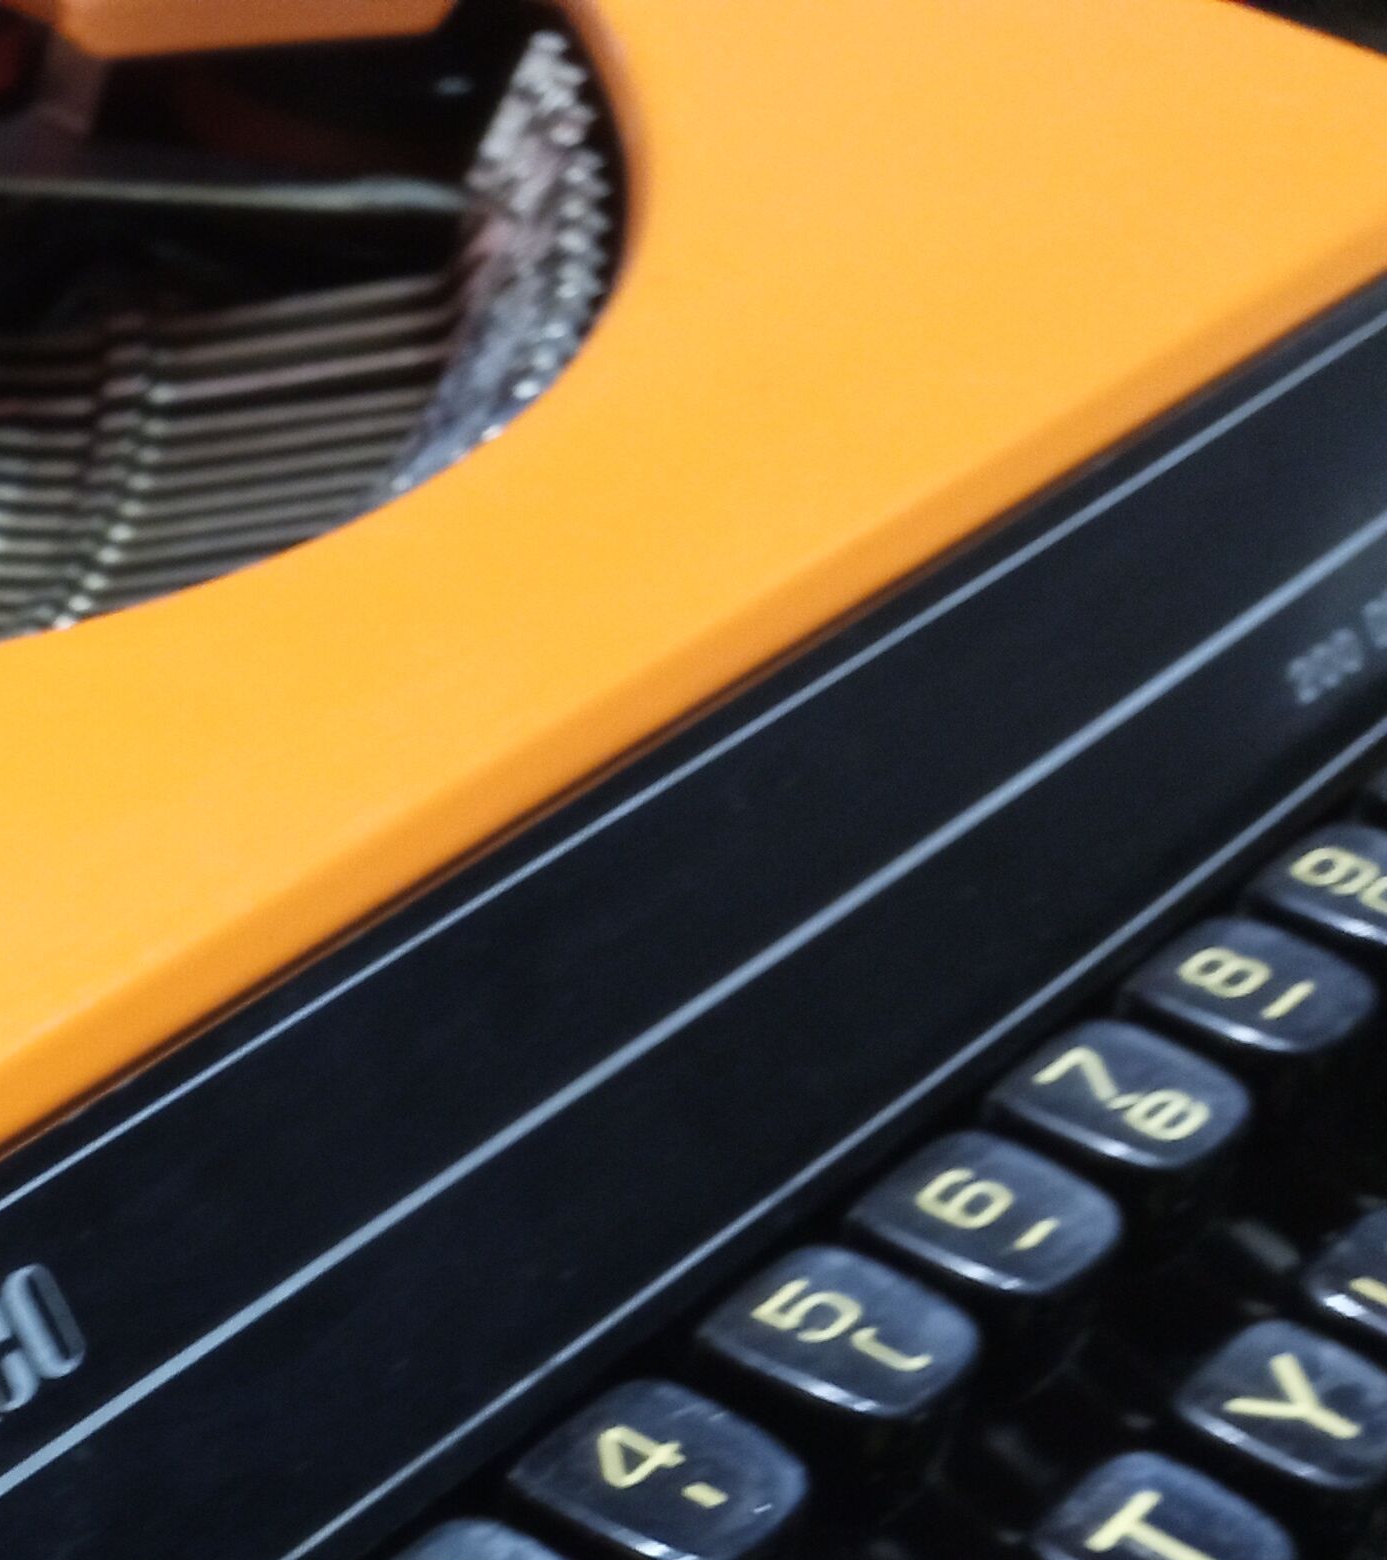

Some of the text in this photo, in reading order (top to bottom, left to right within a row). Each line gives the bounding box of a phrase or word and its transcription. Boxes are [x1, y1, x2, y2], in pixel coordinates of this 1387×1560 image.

[1289, 846, 1380, 896] 9
[1178, 944, 1274, 999] 8
[1031, 1045, 1121, 1101] 7
[914, 1167, 1016, 1231] 6
[749, 1278, 865, 1344] 5
[1222, 1351, 1364, 1441] Y
[596, 1424, 687, 1490] 4
